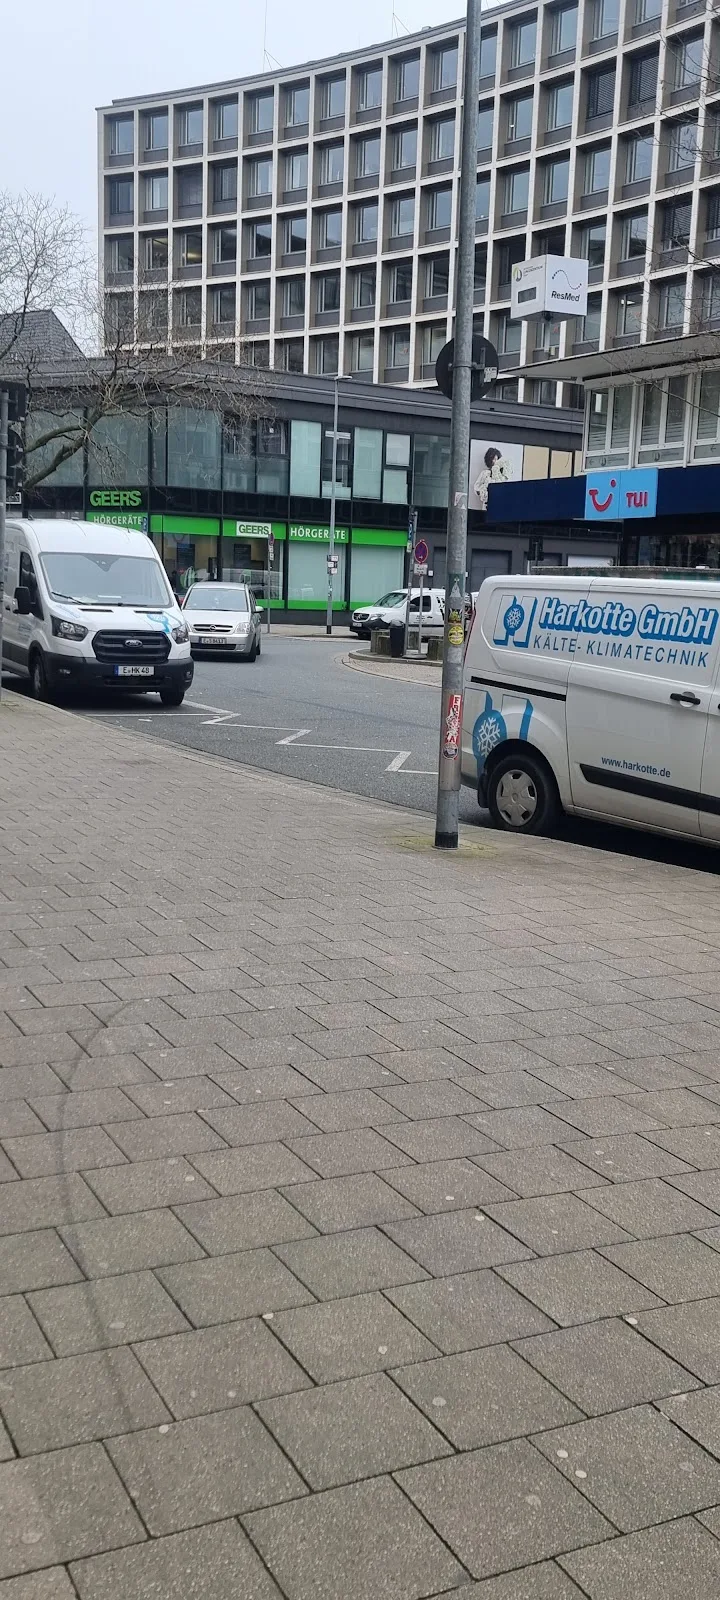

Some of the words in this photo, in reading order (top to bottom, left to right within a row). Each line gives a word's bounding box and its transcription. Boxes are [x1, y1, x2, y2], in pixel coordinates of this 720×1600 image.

[551, 290, 580, 302] ResMed
[90, 490, 142, 507] GEERS
[626, 491, 648, 508] TUI
[93, 514, 142, 525] HÖRGERÄTE
[238, 524, 270, 535] GEERS
[290, 526, 346, 540] HÖRGERTE
[538, 597, 637, 637] Harkotte
[637, 603, 720, 646] GmbH
[533, 632, 582, 653] KÄLTE-
[586, 639, 709, 668] KLIMATECHNIK
[601, 757, 671, 778] www.harkotte.de
